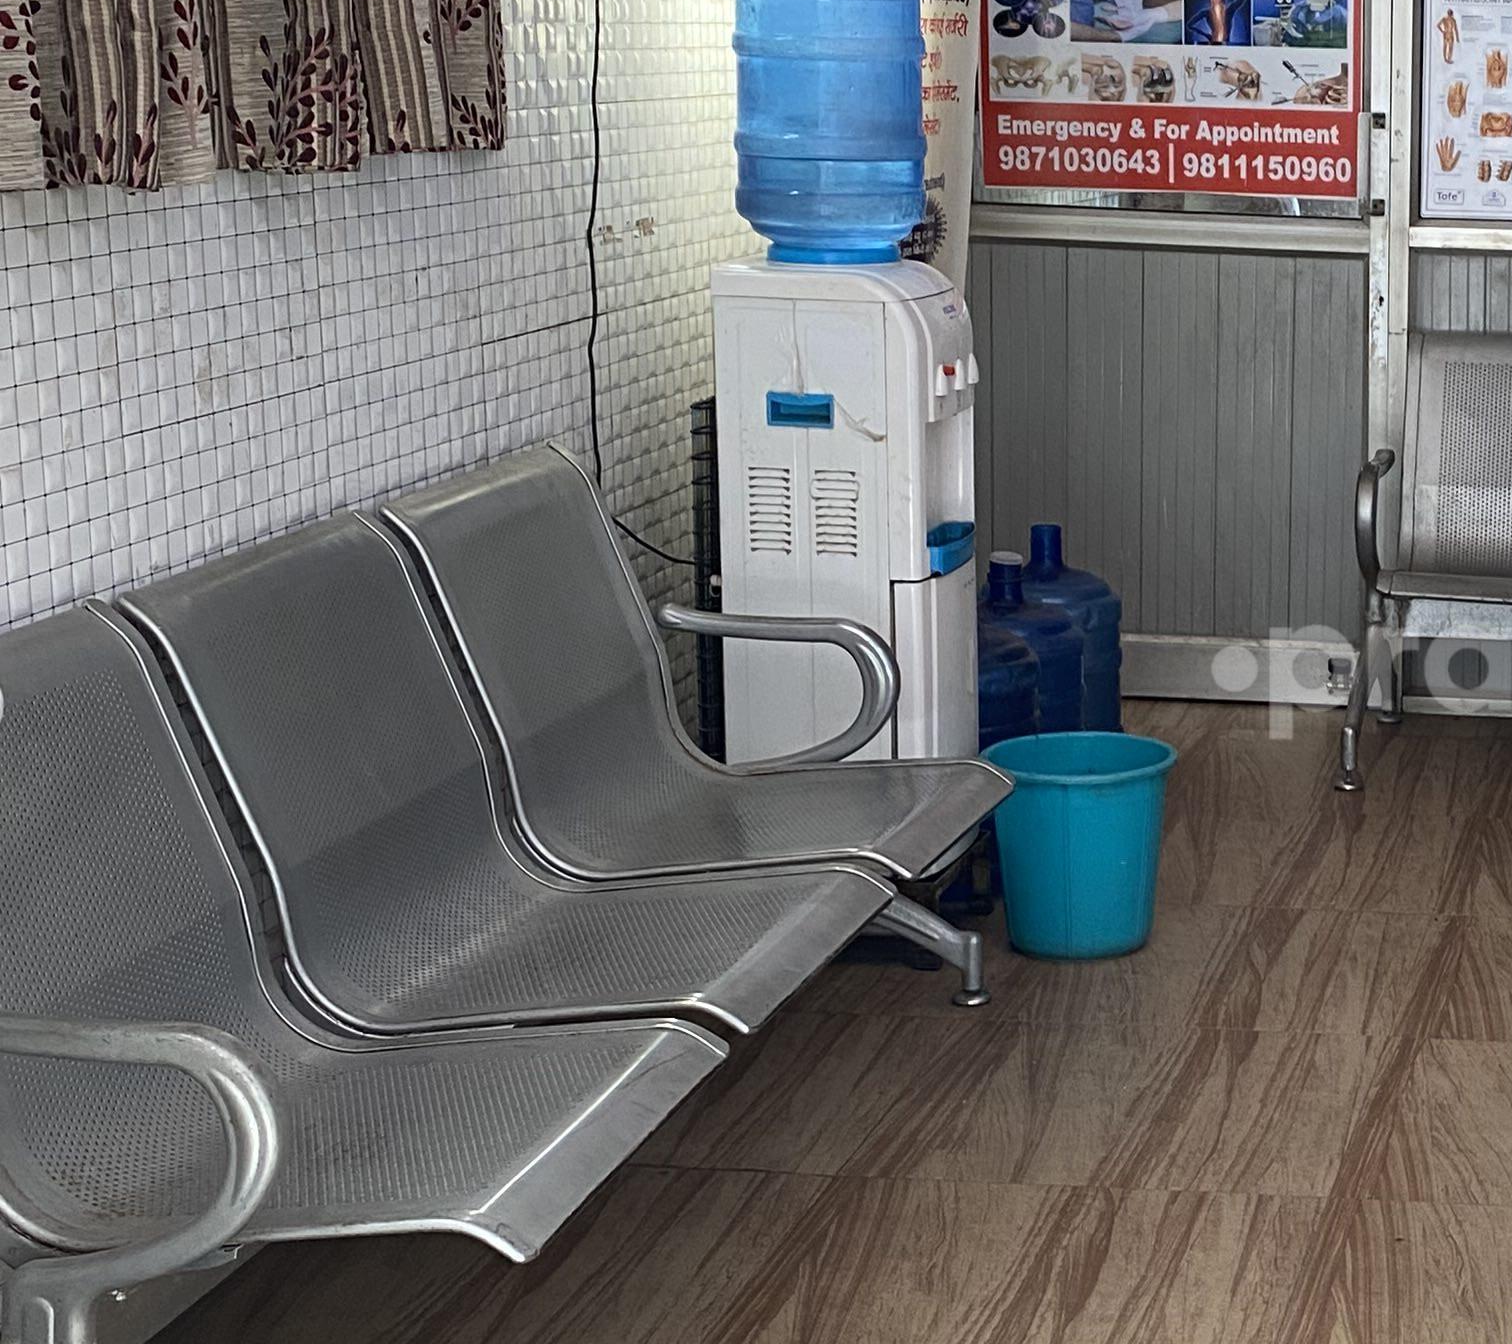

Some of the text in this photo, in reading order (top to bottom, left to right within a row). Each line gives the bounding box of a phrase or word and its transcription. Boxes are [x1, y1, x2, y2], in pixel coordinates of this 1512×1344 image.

[997, 114, 1339, 146] Emergency & For Appointment
[998, 144, 1352, 184] 9871030643 9811150960
